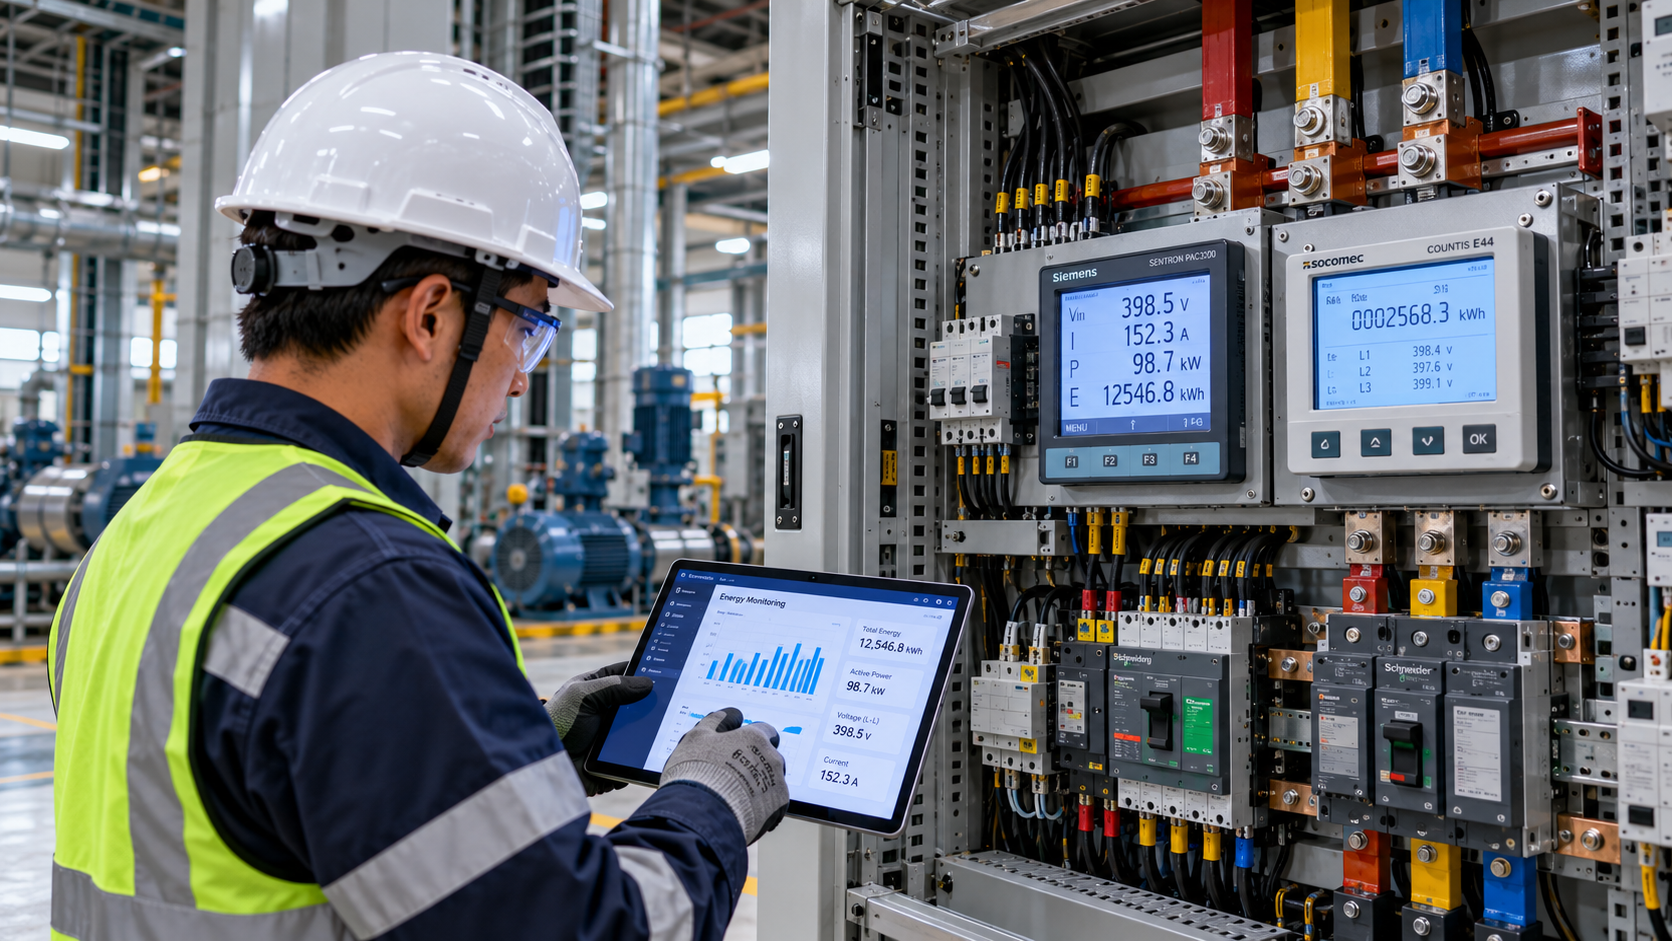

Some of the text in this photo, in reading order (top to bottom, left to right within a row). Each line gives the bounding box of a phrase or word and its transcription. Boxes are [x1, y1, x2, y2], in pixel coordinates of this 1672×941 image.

[1427, 236, 1494, 254] COUNTIS E44
[1149, 255, 1184, 267] SENTRON
[1311, 254, 1364, 269] socomec
[1053, 268, 1098, 283] Siemens
[1122, 292, 1174, 319] 398.5
[1180, 298, 1189, 311] V
[1352, 302, 1485, 331] 0002568.3 kWh
[1125, 321, 1174, 346] 152.3
[1180, 328, 1189, 341] A
[1360, 350, 1370, 360] L1
[1413, 345, 1441, 357] 398.4
[1070, 350, 1201, 378] P 98.7 kW
[1360, 366, 1371, 377] L2
[1413, 361, 1441, 373] 397.6
[1360, 382, 1371, 393] L3
[1413, 378, 1441, 390] 399.1
[1070, 380, 1204, 407] E 12546.8 kWh
[1065, 423, 1088, 432] MENU
[1470, 433, 1487, 445] OK
[1066, 454, 1197, 467] F1 F2 F3 F4
[719, 593, 786, 609] Energy Monitoring
[879, 628, 901, 638] Energy
[860, 638, 923, 655] 12,546.8 kWh
[850, 668, 892, 680] Active Power
[1385, 663, 1433, 675] Schneider
[846, 680, 885, 695] 98.7 kW
[837, 712, 861, 722] Voltage
[833, 724, 864, 739] 398.5
[823, 756, 849, 767] Current
[820, 769, 858, 787] 152.3 A
